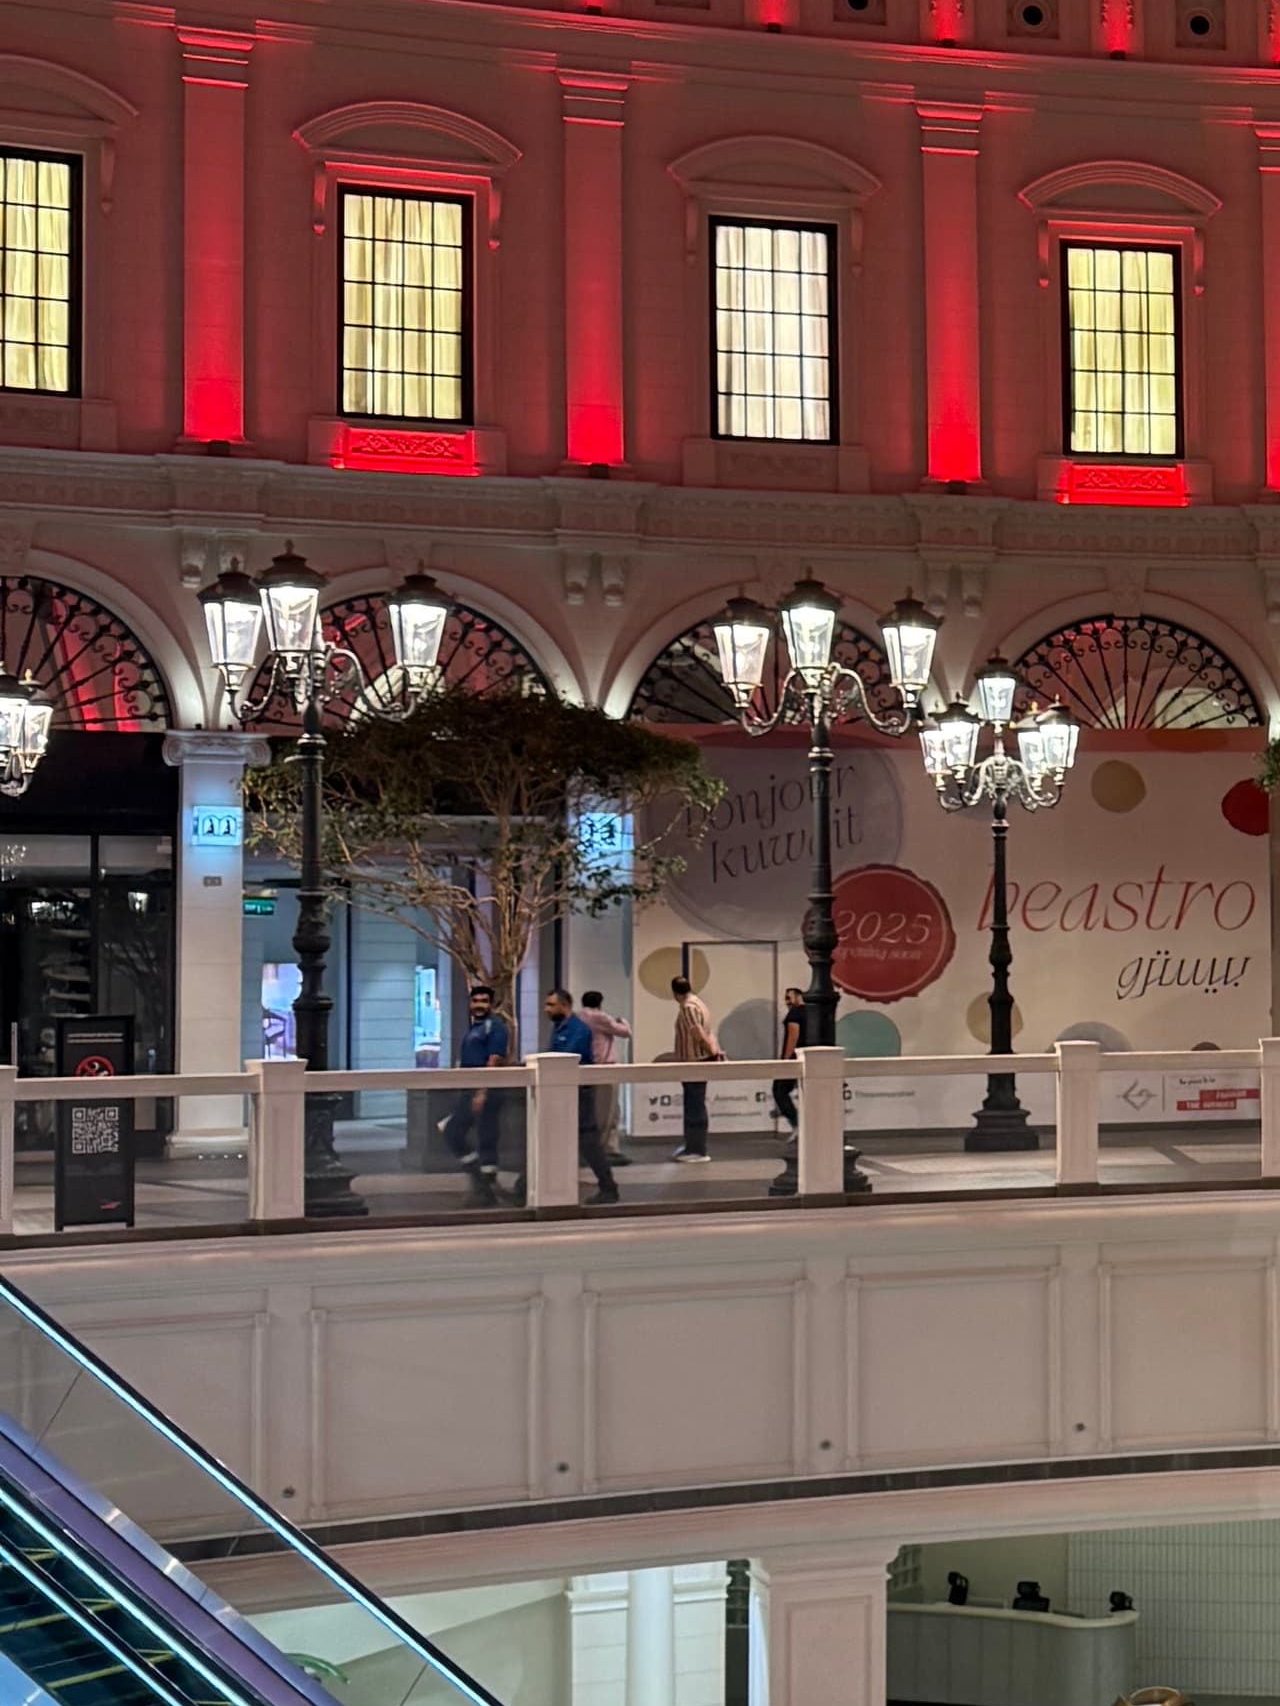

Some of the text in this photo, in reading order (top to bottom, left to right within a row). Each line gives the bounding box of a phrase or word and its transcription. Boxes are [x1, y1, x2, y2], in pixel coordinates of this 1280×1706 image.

[711, 805, 864, 883] kuwit
[836, 909, 932, 944] 2025
[976, 864, 1256, 932] beastro
